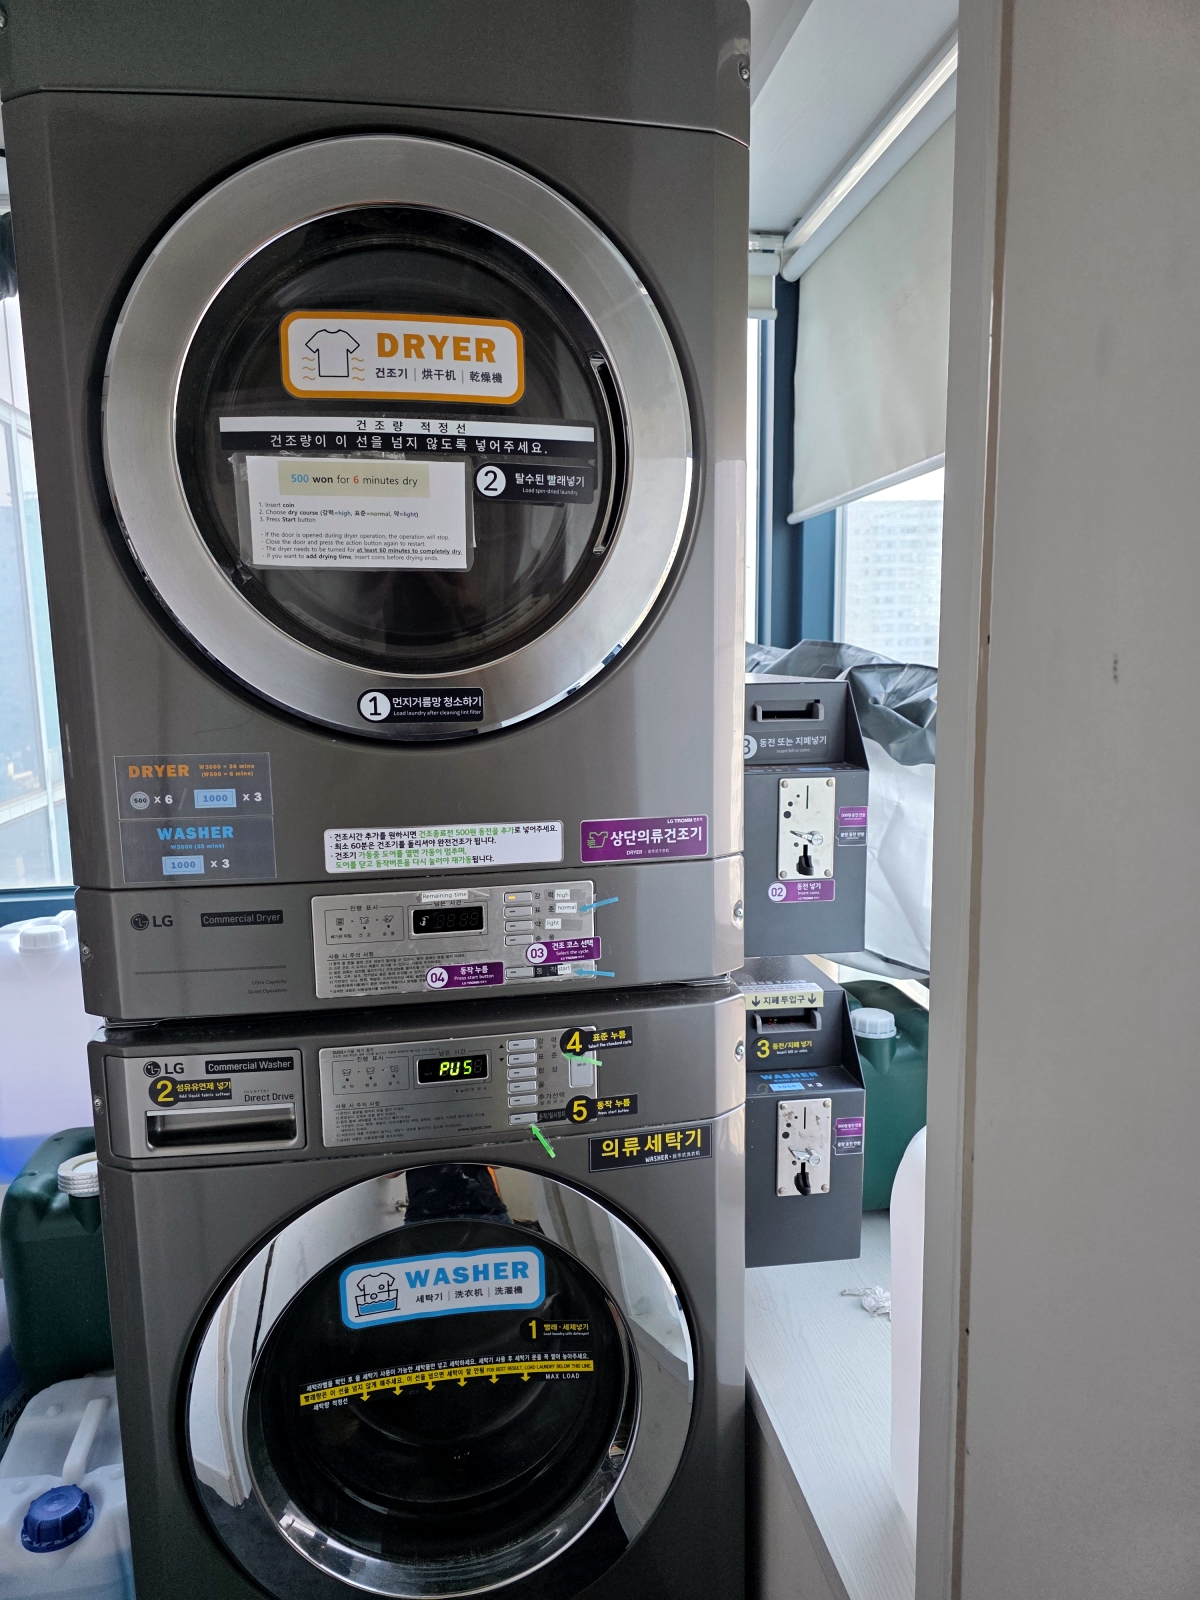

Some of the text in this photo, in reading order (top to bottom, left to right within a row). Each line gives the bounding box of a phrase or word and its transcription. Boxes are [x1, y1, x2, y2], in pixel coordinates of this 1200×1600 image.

[377, 332, 496, 364] DRYER
[375, 367, 408, 380] 건조기
[421, 368, 456, 382] 烘干机
[469, 371, 503, 384] 乾燥機
[270, 434, 548, 455] 건조량이 이 선을 넘지 않도록 넣어주세요.
[291, 474, 418, 487] 500 won for 6 minutes dry
[483, 470, 498, 491] 2
[515, 472, 585, 488] 탈수된 빨래넣기
[368, 695, 382, 716] 1
[392, 696, 482, 709] 먼지거름망 청소하기
[759, 735, 827, 748] 동전 또는 지폐넣기
[128, 764, 190, 778] DRYER
[164, 795, 173, 804] 6
[203, 794, 228, 803] 1000
[253, 792, 262, 802] 3
[157, 826, 234, 840] WASHER
[334, 824, 558, 842] 건조시간 추가를 원하시면 건조종료전 500원 동전을 추가로 넣어주세요.
[610, 826, 702, 847] 상단의류건조기
[334, 841, 350, 851] 최소
[350, 841, 376, 850] 60분은
[377, 840, 406, 850] 건조기를
[437, 837, 473, 847] 완전건조가
[473, 837, 497, 846] 됩니다.
[335, 851, 357, 861] 건조기
[358, 851, 380, 860] 가동중
[382, 849, 404, 858] 도어를
[405, 849, 420, 858] 열면
[421, 848, 442, 857] 가동이
[171, 861, 196, 870] 1000
[221, 858, 230, 868] 3
[335, 860, 357, 870] 도어를
[358, 860, 374, 869] 닫고
[375, 859, 411, 868] 동작버튼을
[412, 858, 427, 867] 다시
[429, 857, 450, 866] 눌러야
[771, 888, 783, 897] 02
[796, 883, 821, 891] 동전 넣기
[556, 891, 570, 899] high
[152, 915, 174, 927] LG
[203, 912, 281, 924] Commercial Dryer
[552, 939, 594, 951] 건조 코스 선택
[530, 948, 544, 958] 03
[460, 965, 489, 975] 동작 누름
[430, 972, 445, 983] 04
[763, 995, 806, 1005] 지폐 투입구
[566, 1031, 583, 1052] 4
[592, 1030, 627, 1042] 표준 누름
[756, 1039, 771, 1059] 3
[772, 1040, 813, 1051] 동전/지폐 넣기
[164, 1063, 185, 1074] LG
[208, 1060, 292, 1072] Commercial Washer
[759, 1071, 820, 1080] WASHER
[156, 1079, 174, 1102] 2
[176, 1081, 232, 1092] 섬유유연제 넣기
[244, 1092, 294, 1102] Direct Drive
[596, 1098, 631, 1109] 동작 누름
[572, 1100, 588, 1121] 5
[645, 1154, 669, 1163] WASHER
[405, 1261, 529, 1289] WASHER
[454, 1288, 483, 1300] 洗衣机
[494, 1285, 523, 1296] 洗濯機
[415, 1292, 443, 1304] 세탁기
[528, 1320, 537, 1339] 1
[313, 1397, 348, 1411] 세탁량 적정선
